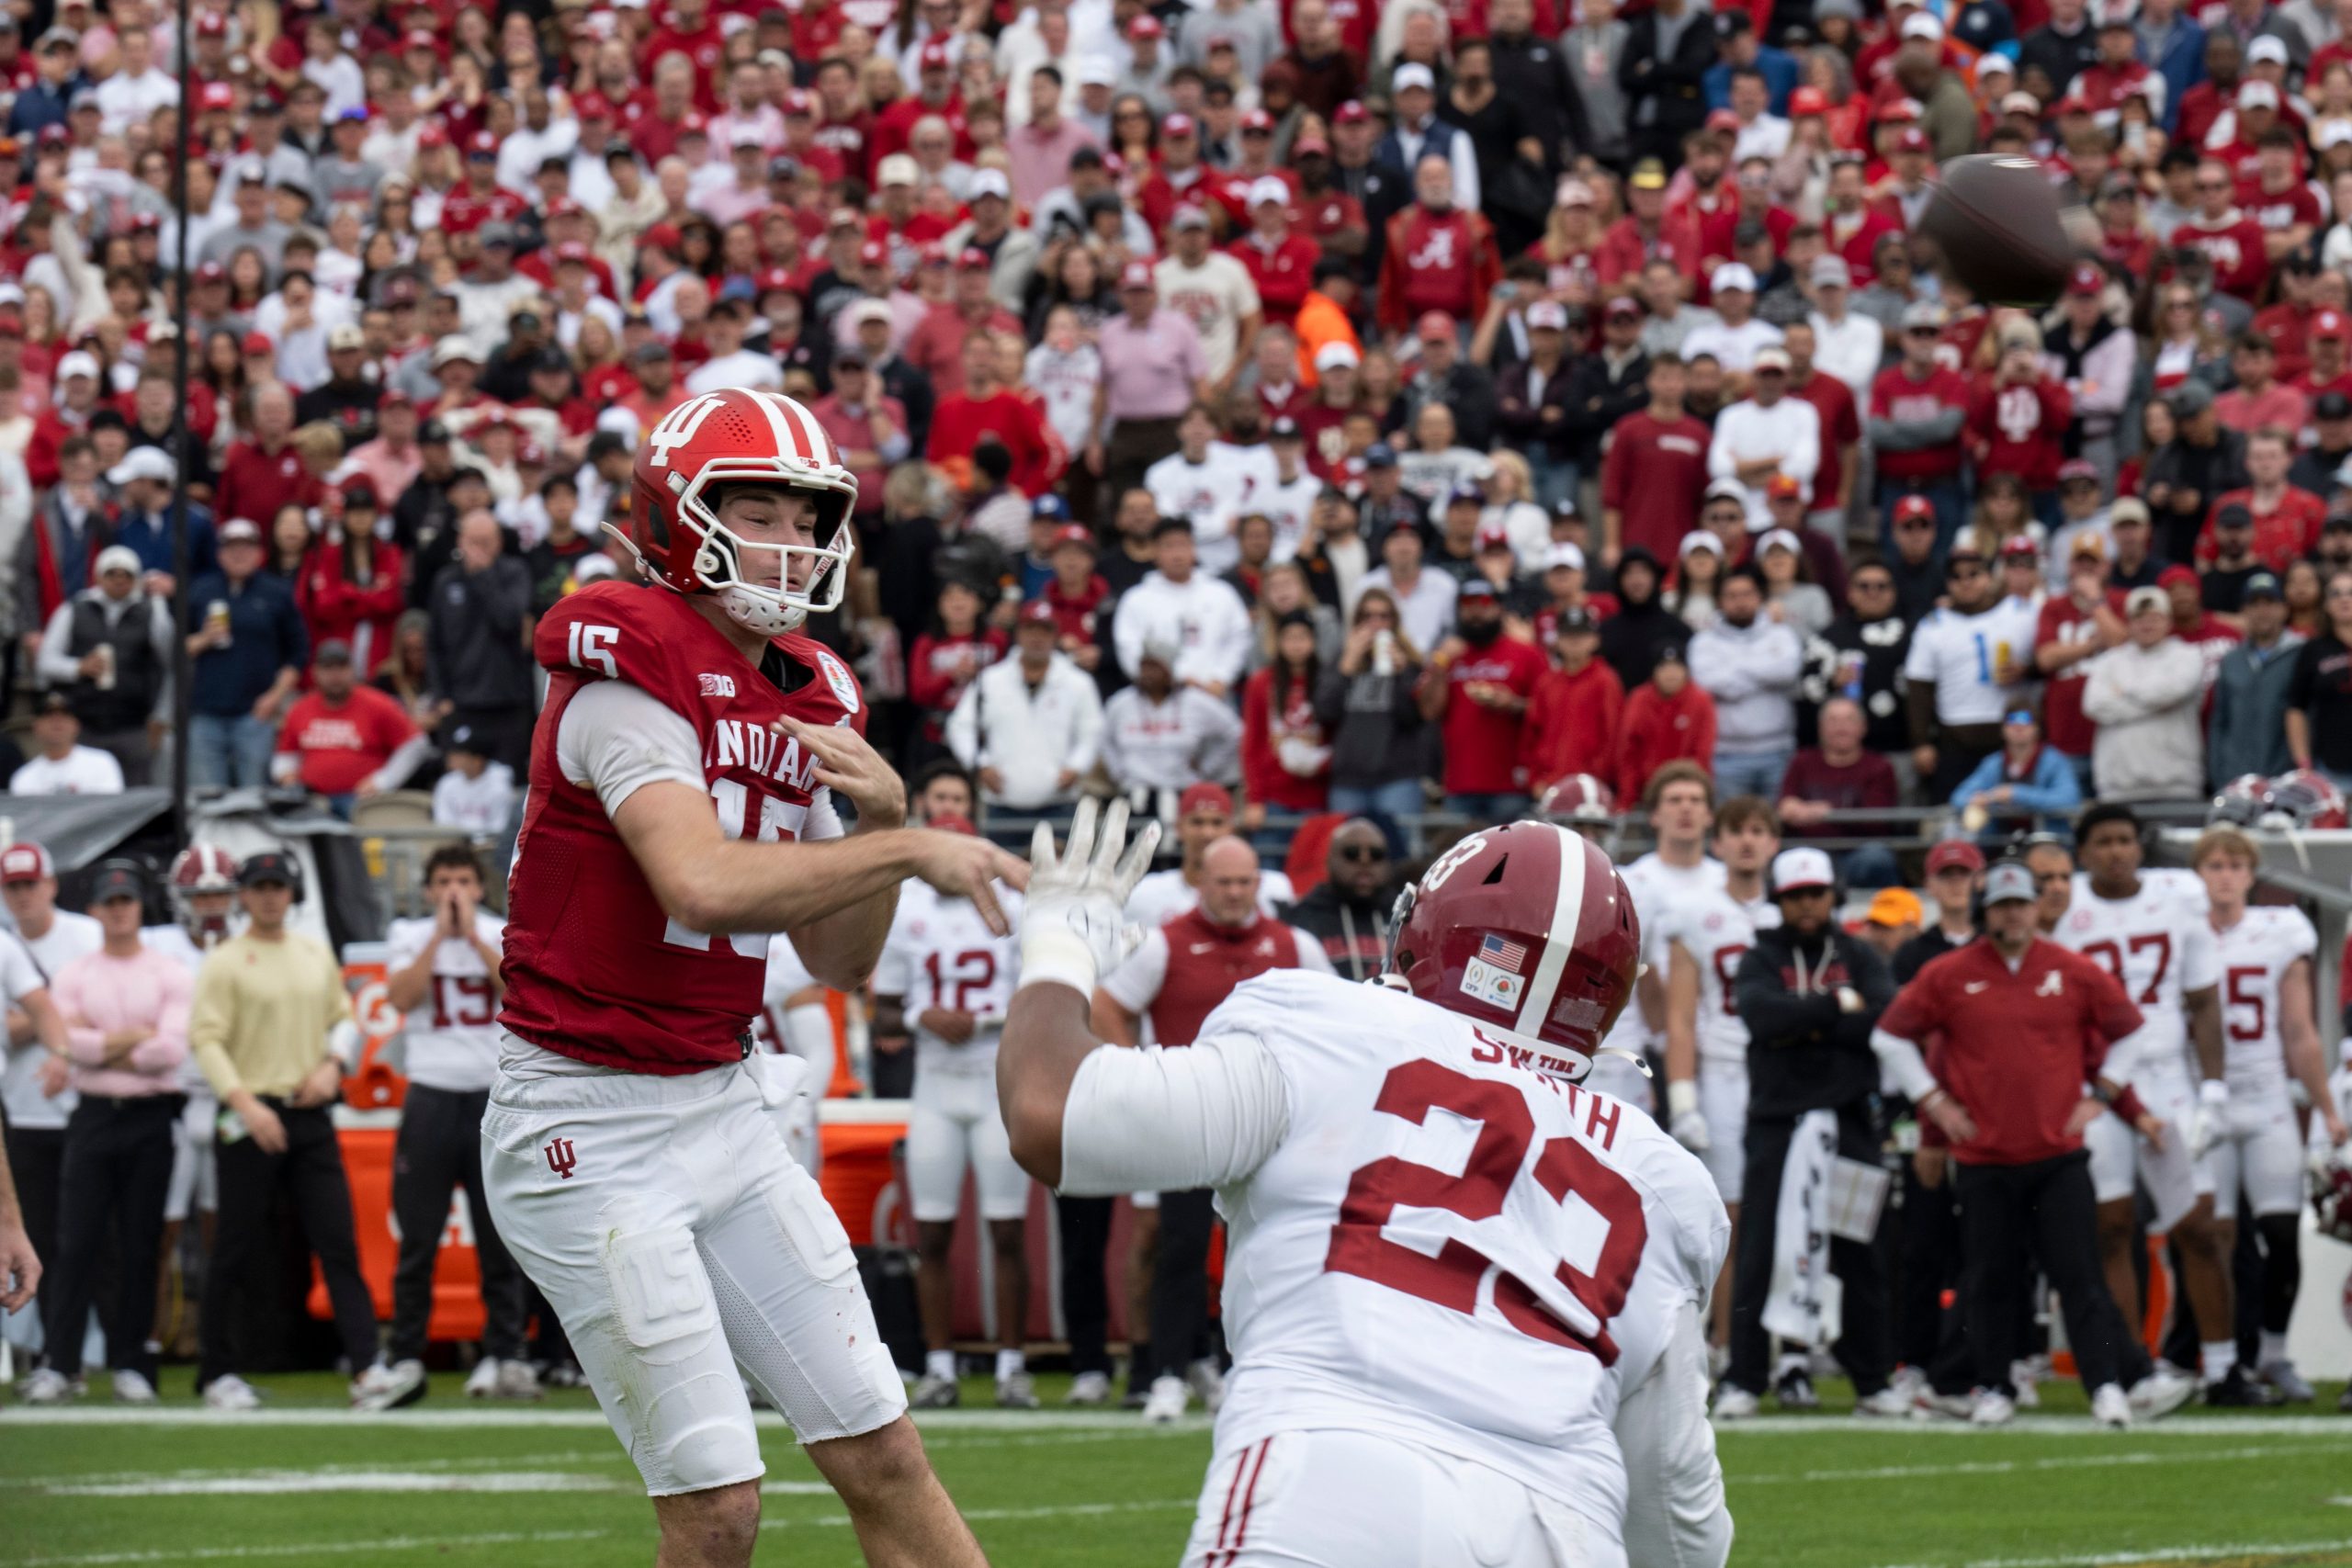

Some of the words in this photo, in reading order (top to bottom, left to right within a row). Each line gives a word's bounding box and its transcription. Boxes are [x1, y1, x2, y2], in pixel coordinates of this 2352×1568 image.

[569, 621, 620, 679] 15
[925, 951, 995, 1013] 12
[1472, 1025, 1621, 1152] STH
[1538, 1055, 1577, 1074] TIDE
[1324, 1056, 1648, 1368] 23
